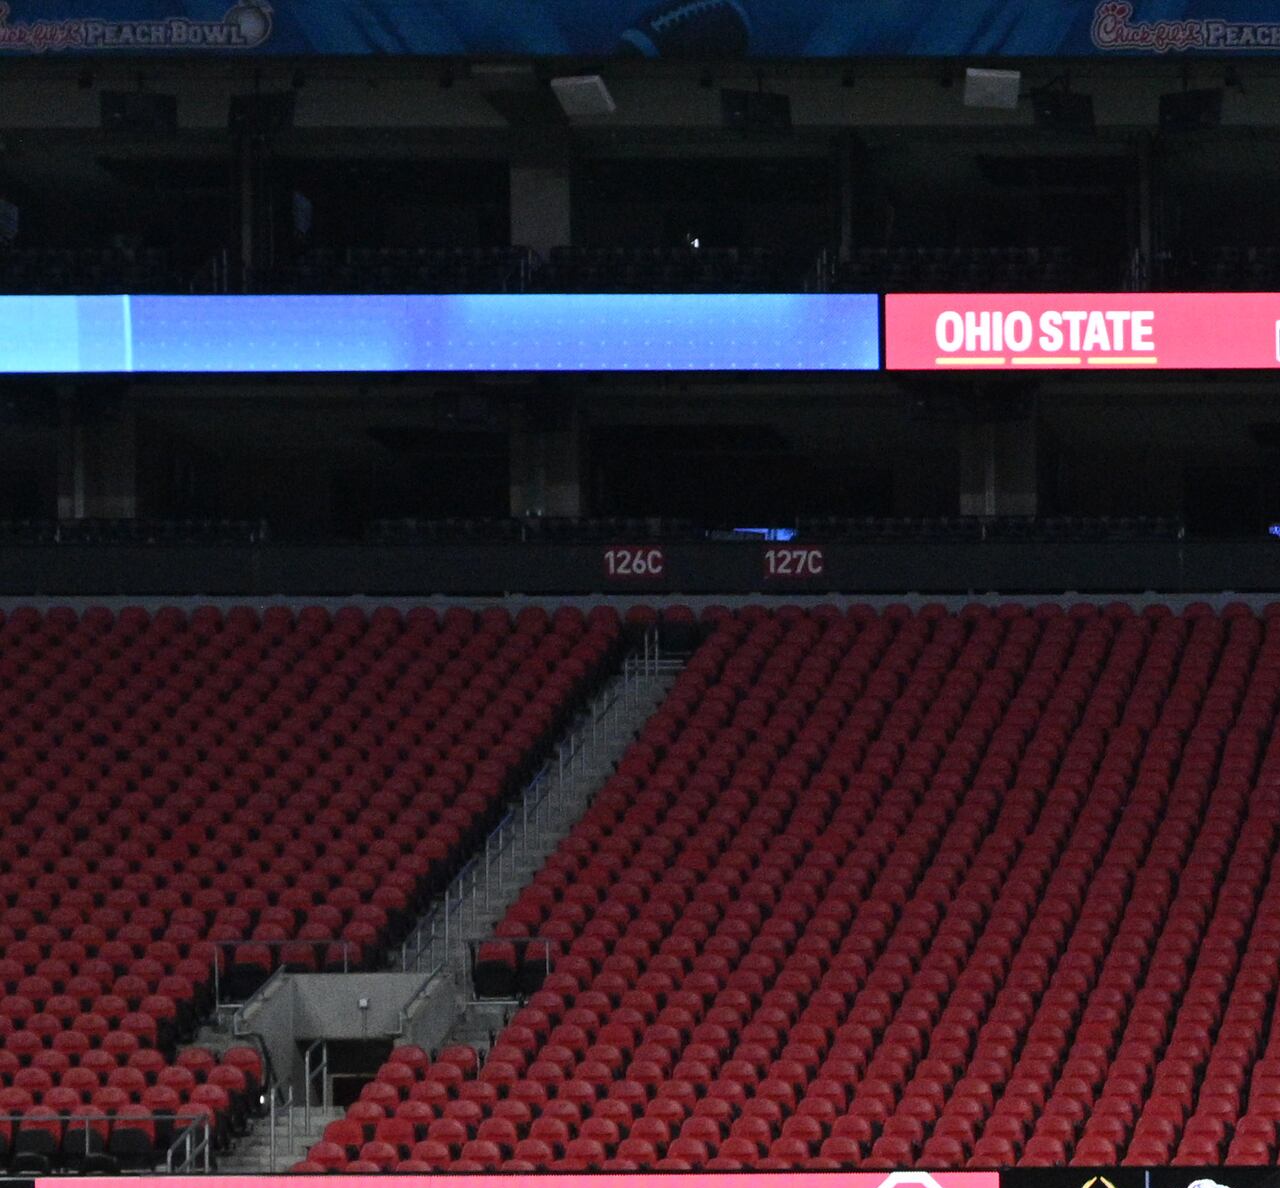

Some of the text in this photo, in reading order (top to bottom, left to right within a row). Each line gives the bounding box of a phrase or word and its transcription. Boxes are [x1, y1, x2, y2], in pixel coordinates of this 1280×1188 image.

[84, 19, 166, 44] PEACH
[170, 18, 247, 44] BOWL
[934, 311, 1155, 352] OHIO STATE
[604, 550, 664, 575] 126C
[764, 550, 824, 575] 127C
